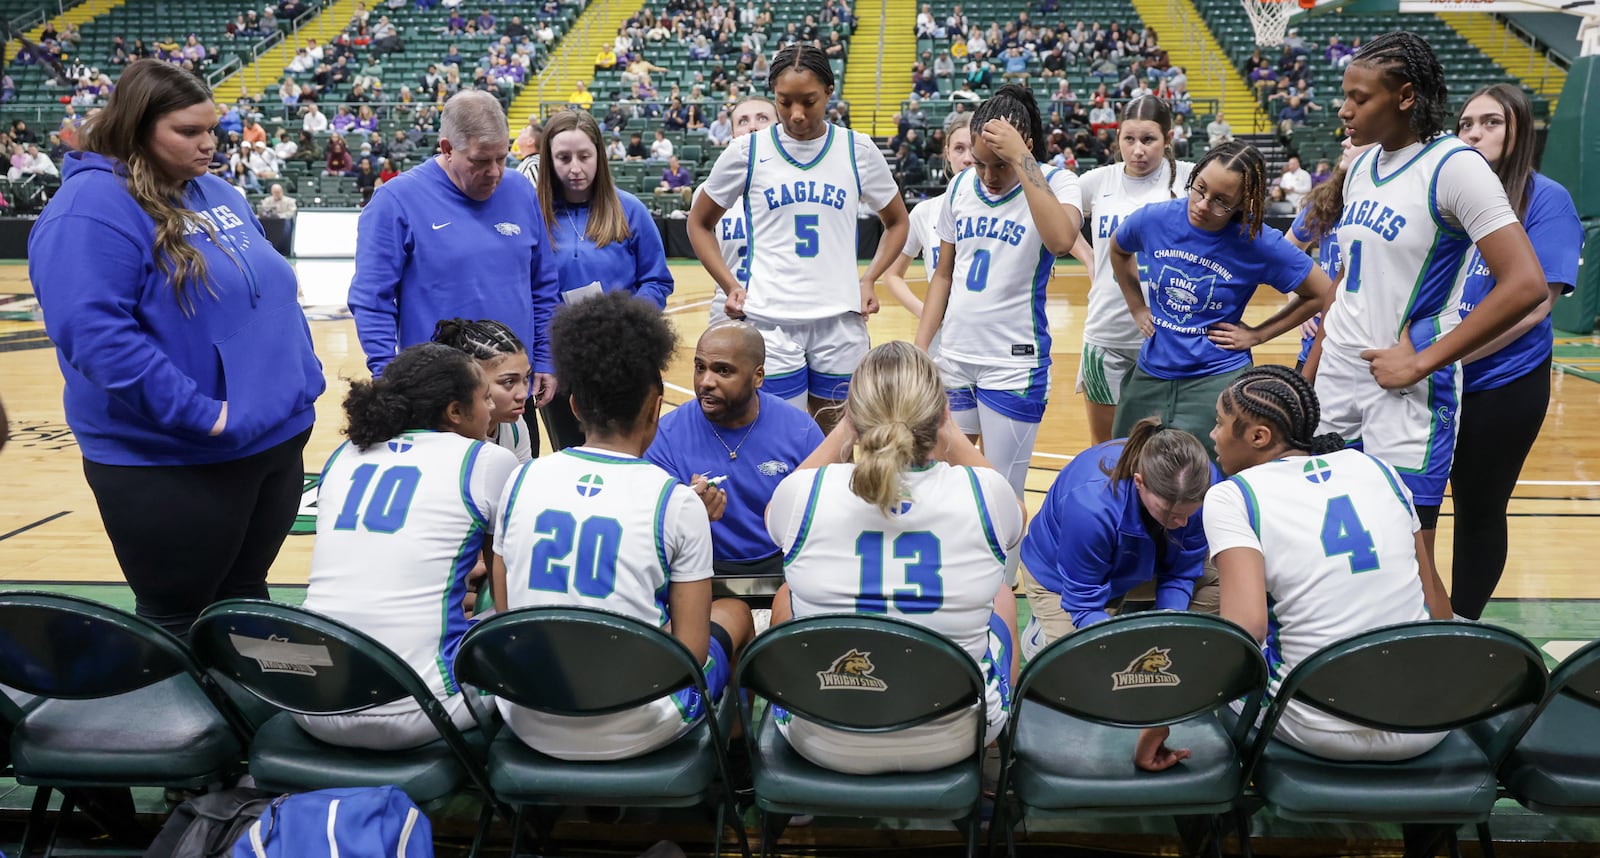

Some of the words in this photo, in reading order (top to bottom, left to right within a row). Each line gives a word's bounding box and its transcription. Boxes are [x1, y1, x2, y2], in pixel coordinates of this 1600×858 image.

[764, 181, 847, 211] EAGLES
[794, 214, 819, 258] 5
[956, 216, 1026, 247] EAGLES
[966, 248, 991, 293] 0
[1154, 249, 1199, 264] CHAMINADE
[1198, 257, 1233, 282] JULIENNE
[1346, 239, 1363, 294] 1
[1475, 264, 1490, 277] 26
[1170, 278, 1198, 294] FINAL
[1166, 299, 1191, 313] FOUR
[1209, 301, 1223, 311] 26
[333, 462, 423, 535] 10
[1319, 494, 1381, 575] 4
[528, 508, 624, 600] 20
[855, 530, 944, 615] 13
[823, 673, 860, 687] WRIGHT
[1118, 674, 1154, 686] WRIGHT
[1155, 674, 1177, 683] STATE
